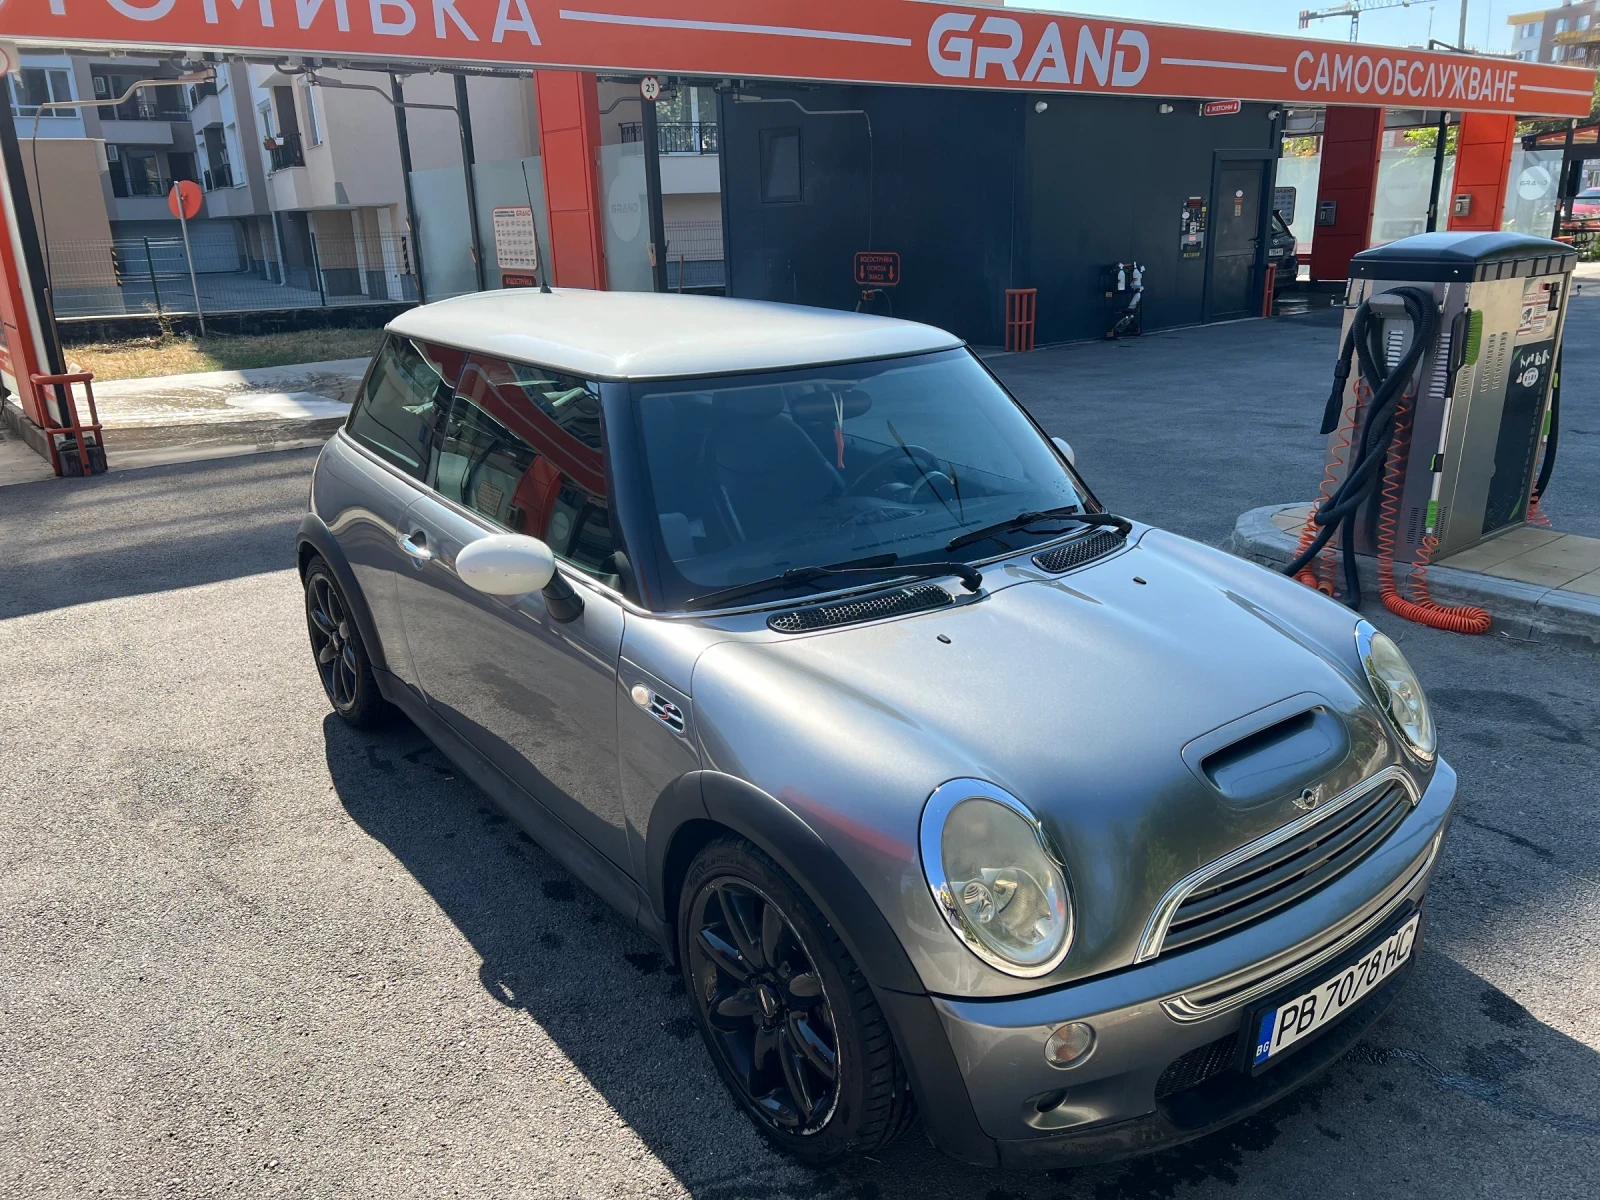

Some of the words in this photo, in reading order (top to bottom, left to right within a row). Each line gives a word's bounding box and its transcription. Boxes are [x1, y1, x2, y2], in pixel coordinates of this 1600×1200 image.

[927, 12, 1150, 87] GRAND
[1294, 50, 1518, 103] САМООБСЛУЖВАНЕ
[611, 203, 639, 214] GRAND
[1276, 994, 1317, 1047] PB
[1319, 950, 1383, 1021] 7078
[1381, 923, 1414, 975] HC
[1255, 1041, 1270, 1057] BG
